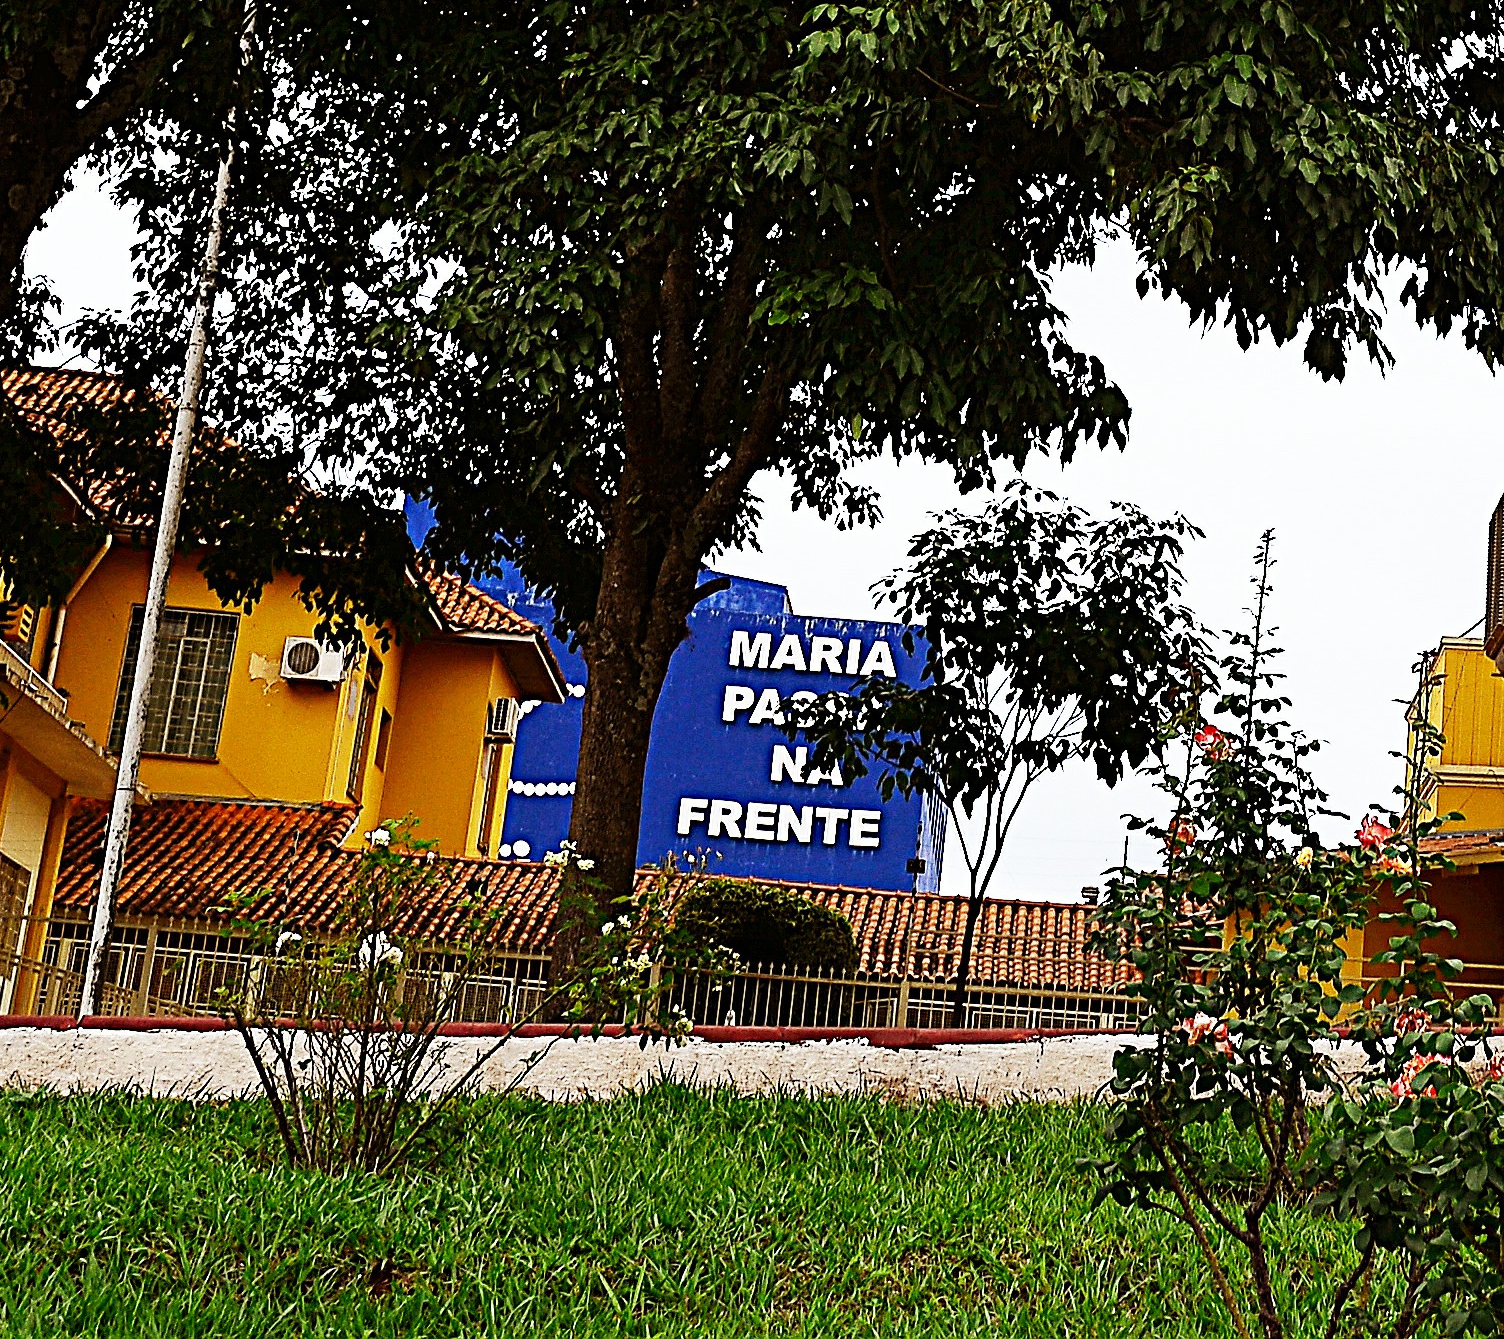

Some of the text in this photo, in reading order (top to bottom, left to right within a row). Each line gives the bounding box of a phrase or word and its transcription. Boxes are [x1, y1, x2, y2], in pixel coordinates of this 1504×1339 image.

[729, 631, 896, 677] MARIA
[770, 744, 844, 786] NA
[677, 798, 881, 847] FRENTE
